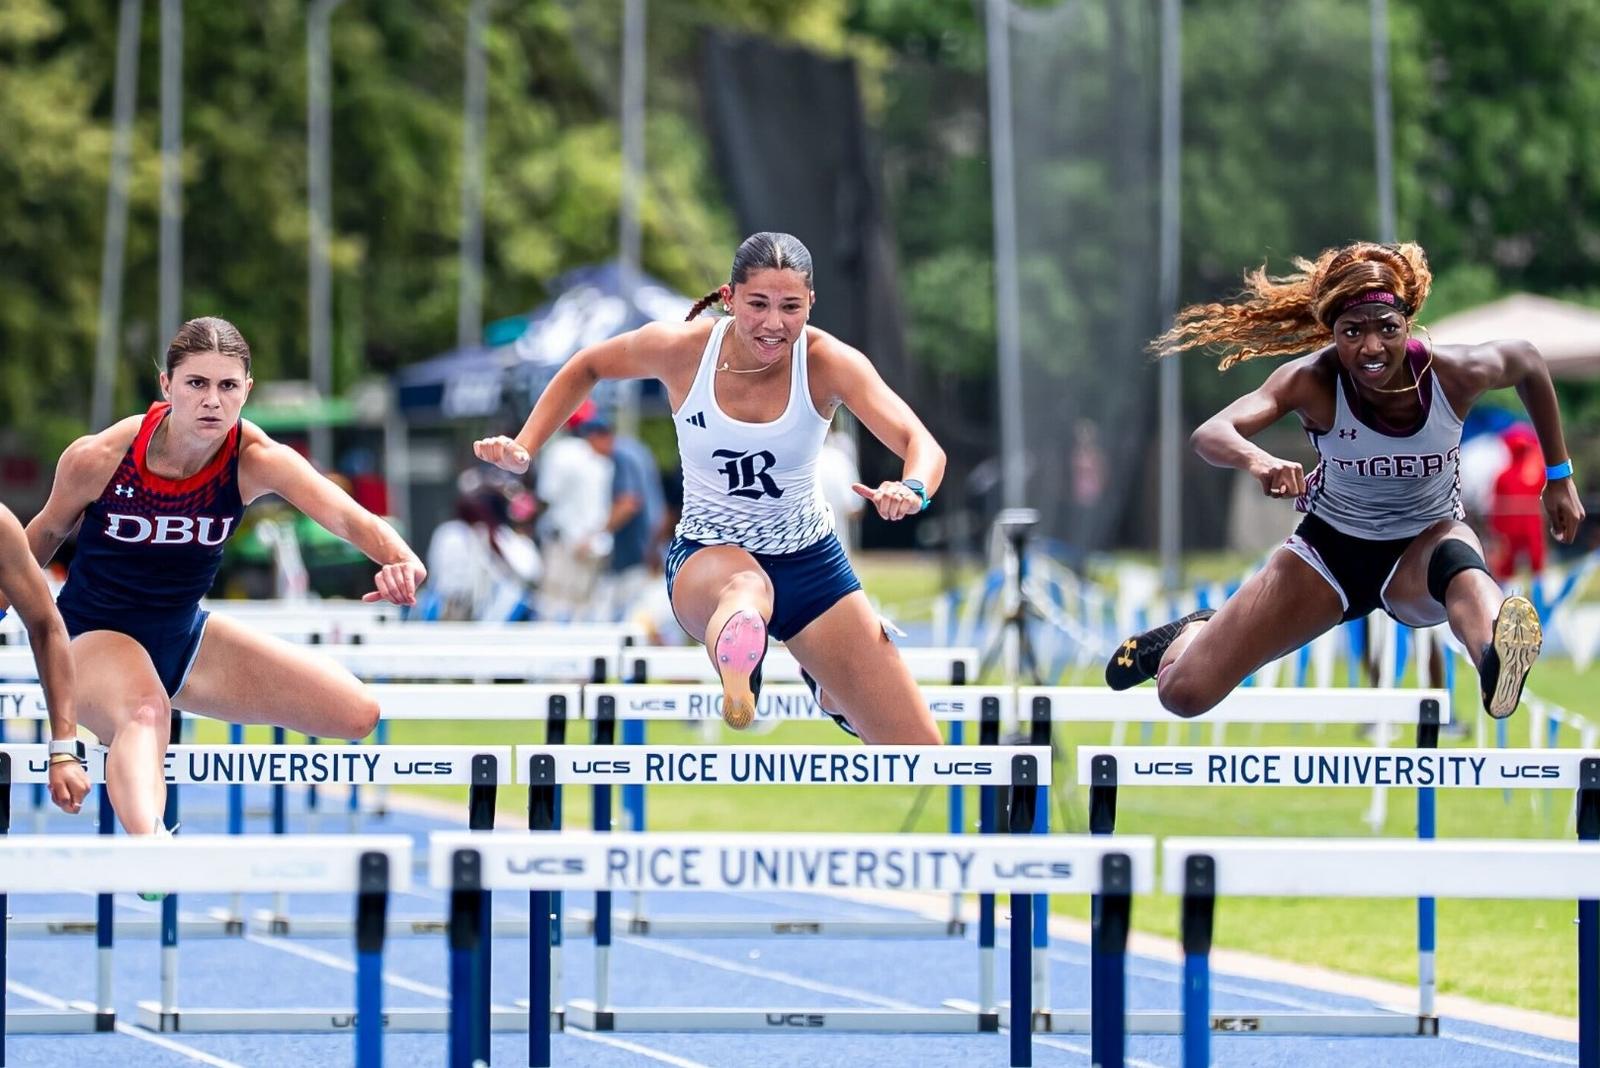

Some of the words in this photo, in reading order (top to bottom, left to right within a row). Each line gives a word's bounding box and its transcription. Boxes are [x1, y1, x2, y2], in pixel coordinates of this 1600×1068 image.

[104, 513, 234, 546] DBU
[630, 699, 677, 711] UCS
[688, 694, 724, 717] RIC
[929, 702, 964, 713] CS
[188, 752, 381, 783] UNIVERSITY
[393, 761, 453, 775] UCS
[572, 760, 631, 774] UCS
[646, 753, 718, 782] RICE
[730, 753, 921, 783] UNIVERSITY
[934, 762, 993, 775] UCS
[1134, 762, 1193, 775] UCS
[1208, 754, 1281, 784] RICE
[1293, 755, 1487, 786] UNIVERSITY
[1500, 765, 1560, 779] UCS
[506, 856, 586, 875] UCS
[607, 849, 702, 886] RICE
[719, 849, 976, 889] UNIVERSITY
[994, 861, 1073, 879] UCS
[766, 1013, 826, 1028] UCS
